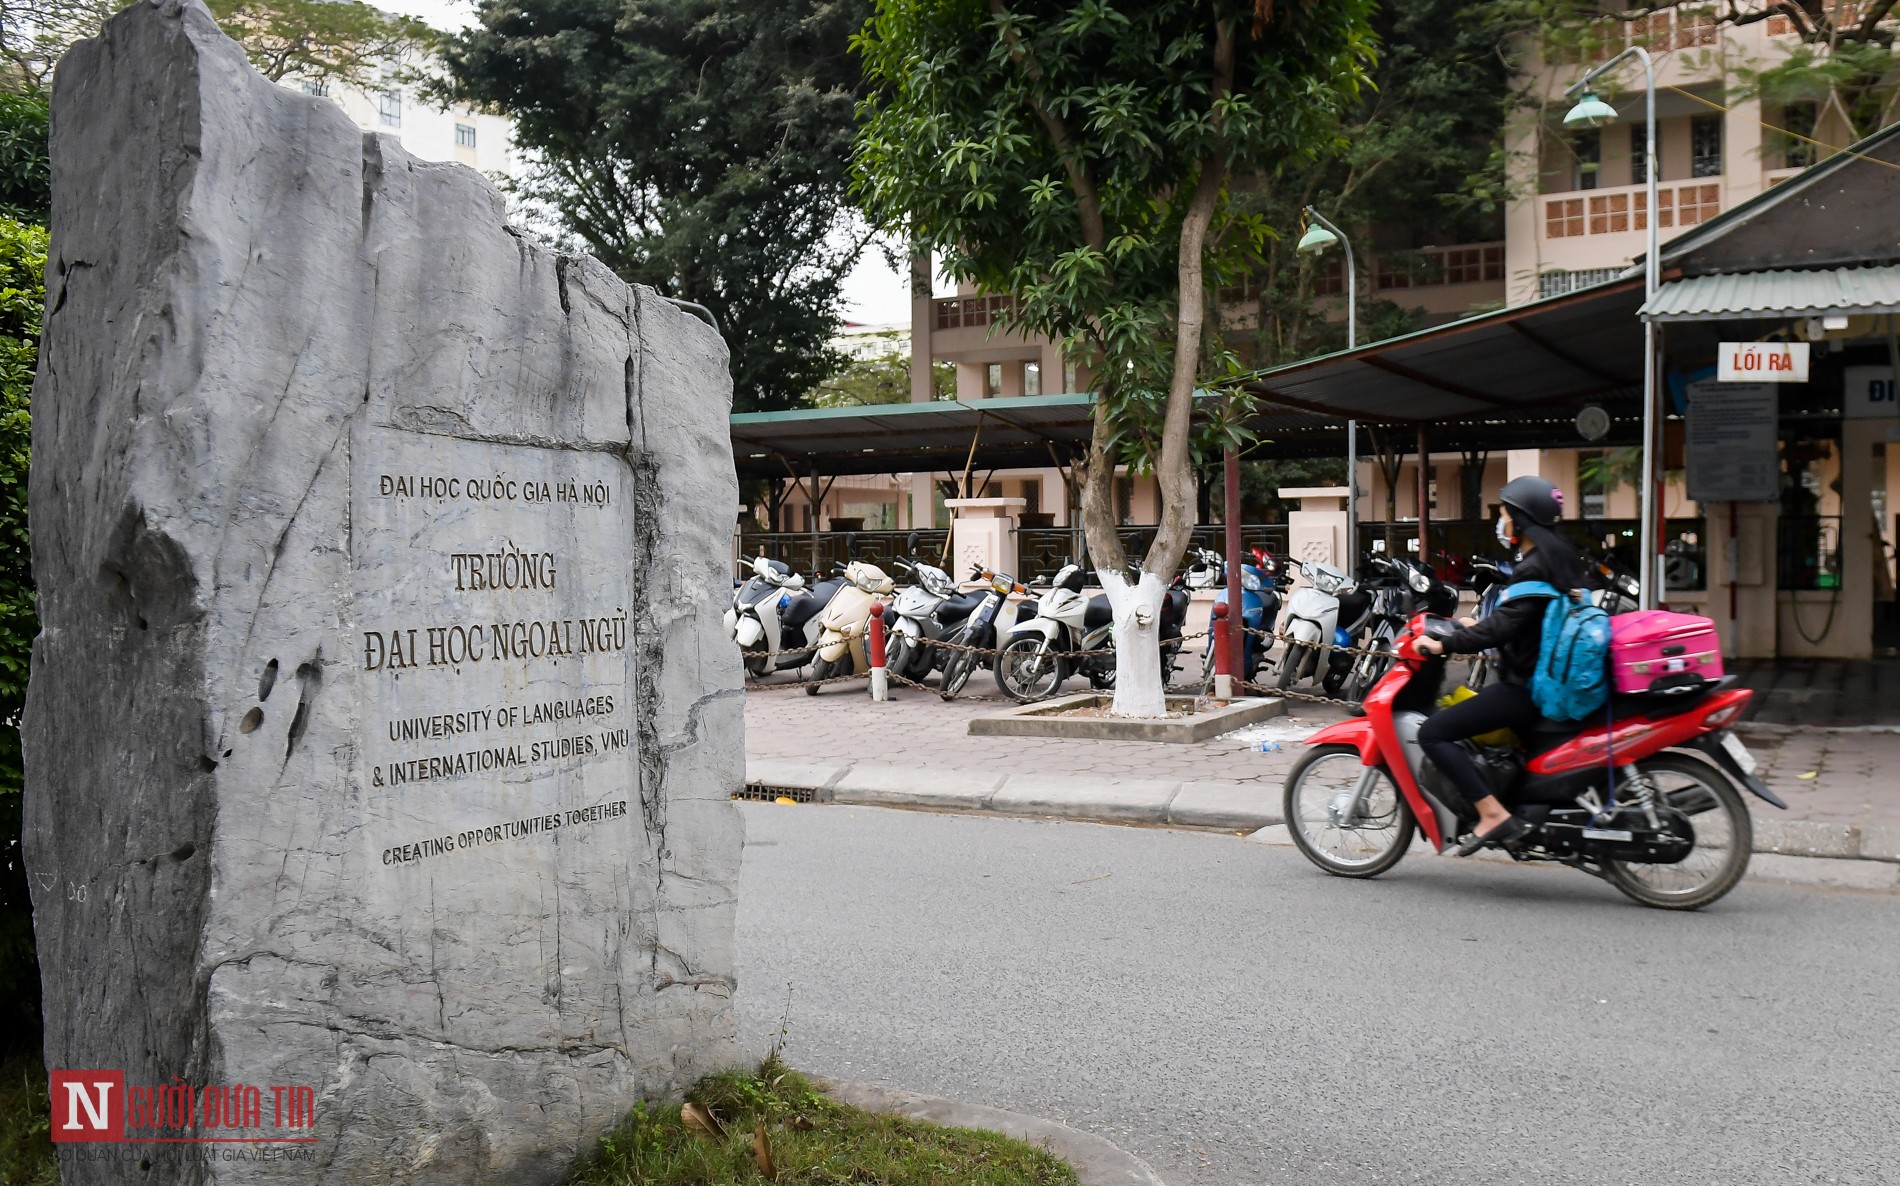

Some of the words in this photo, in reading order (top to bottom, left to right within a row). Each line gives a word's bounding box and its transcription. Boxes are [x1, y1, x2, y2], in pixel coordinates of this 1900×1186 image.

[1734, 346, 1762, 371] LỐI
[1769, 353, 1793, 371] RA
[380, 474, 414, 504] ĐẠI
[420, 476, 460, 504] HỌC
[466, 472, 517, 501] QUỐC
[523, 481, 551, 503] GIA
[557, 477, 578, 503] HÀ
[583, 480, 611, 509] NỘI
[451, 540, 556, 592] TRƯỜNG
[364, 629, 418, 679] ĐẠI
[427, 625, 483, 675] HỌC
[491, 619, 573, 667] NGOẠI
[579, 607, 629, 654] NGỮ
[389, 709, 492, 741] UNIVERSITY
[497, 706, 518, 728] OF
[523, 695, 614, 725] LANGUAGES
[372, 765, 384, 787] &
[389, 745, 526, 787] INTERNATIONAL
[531, 735, 598, 762] STUDIES,
[601, 729, 629, 751] VNU
[382, 836, 454, 866] CREATING
[457, 813, 561, 849] OPPORTUNITIES
[565, 800, 627, 827] TOGETHER
